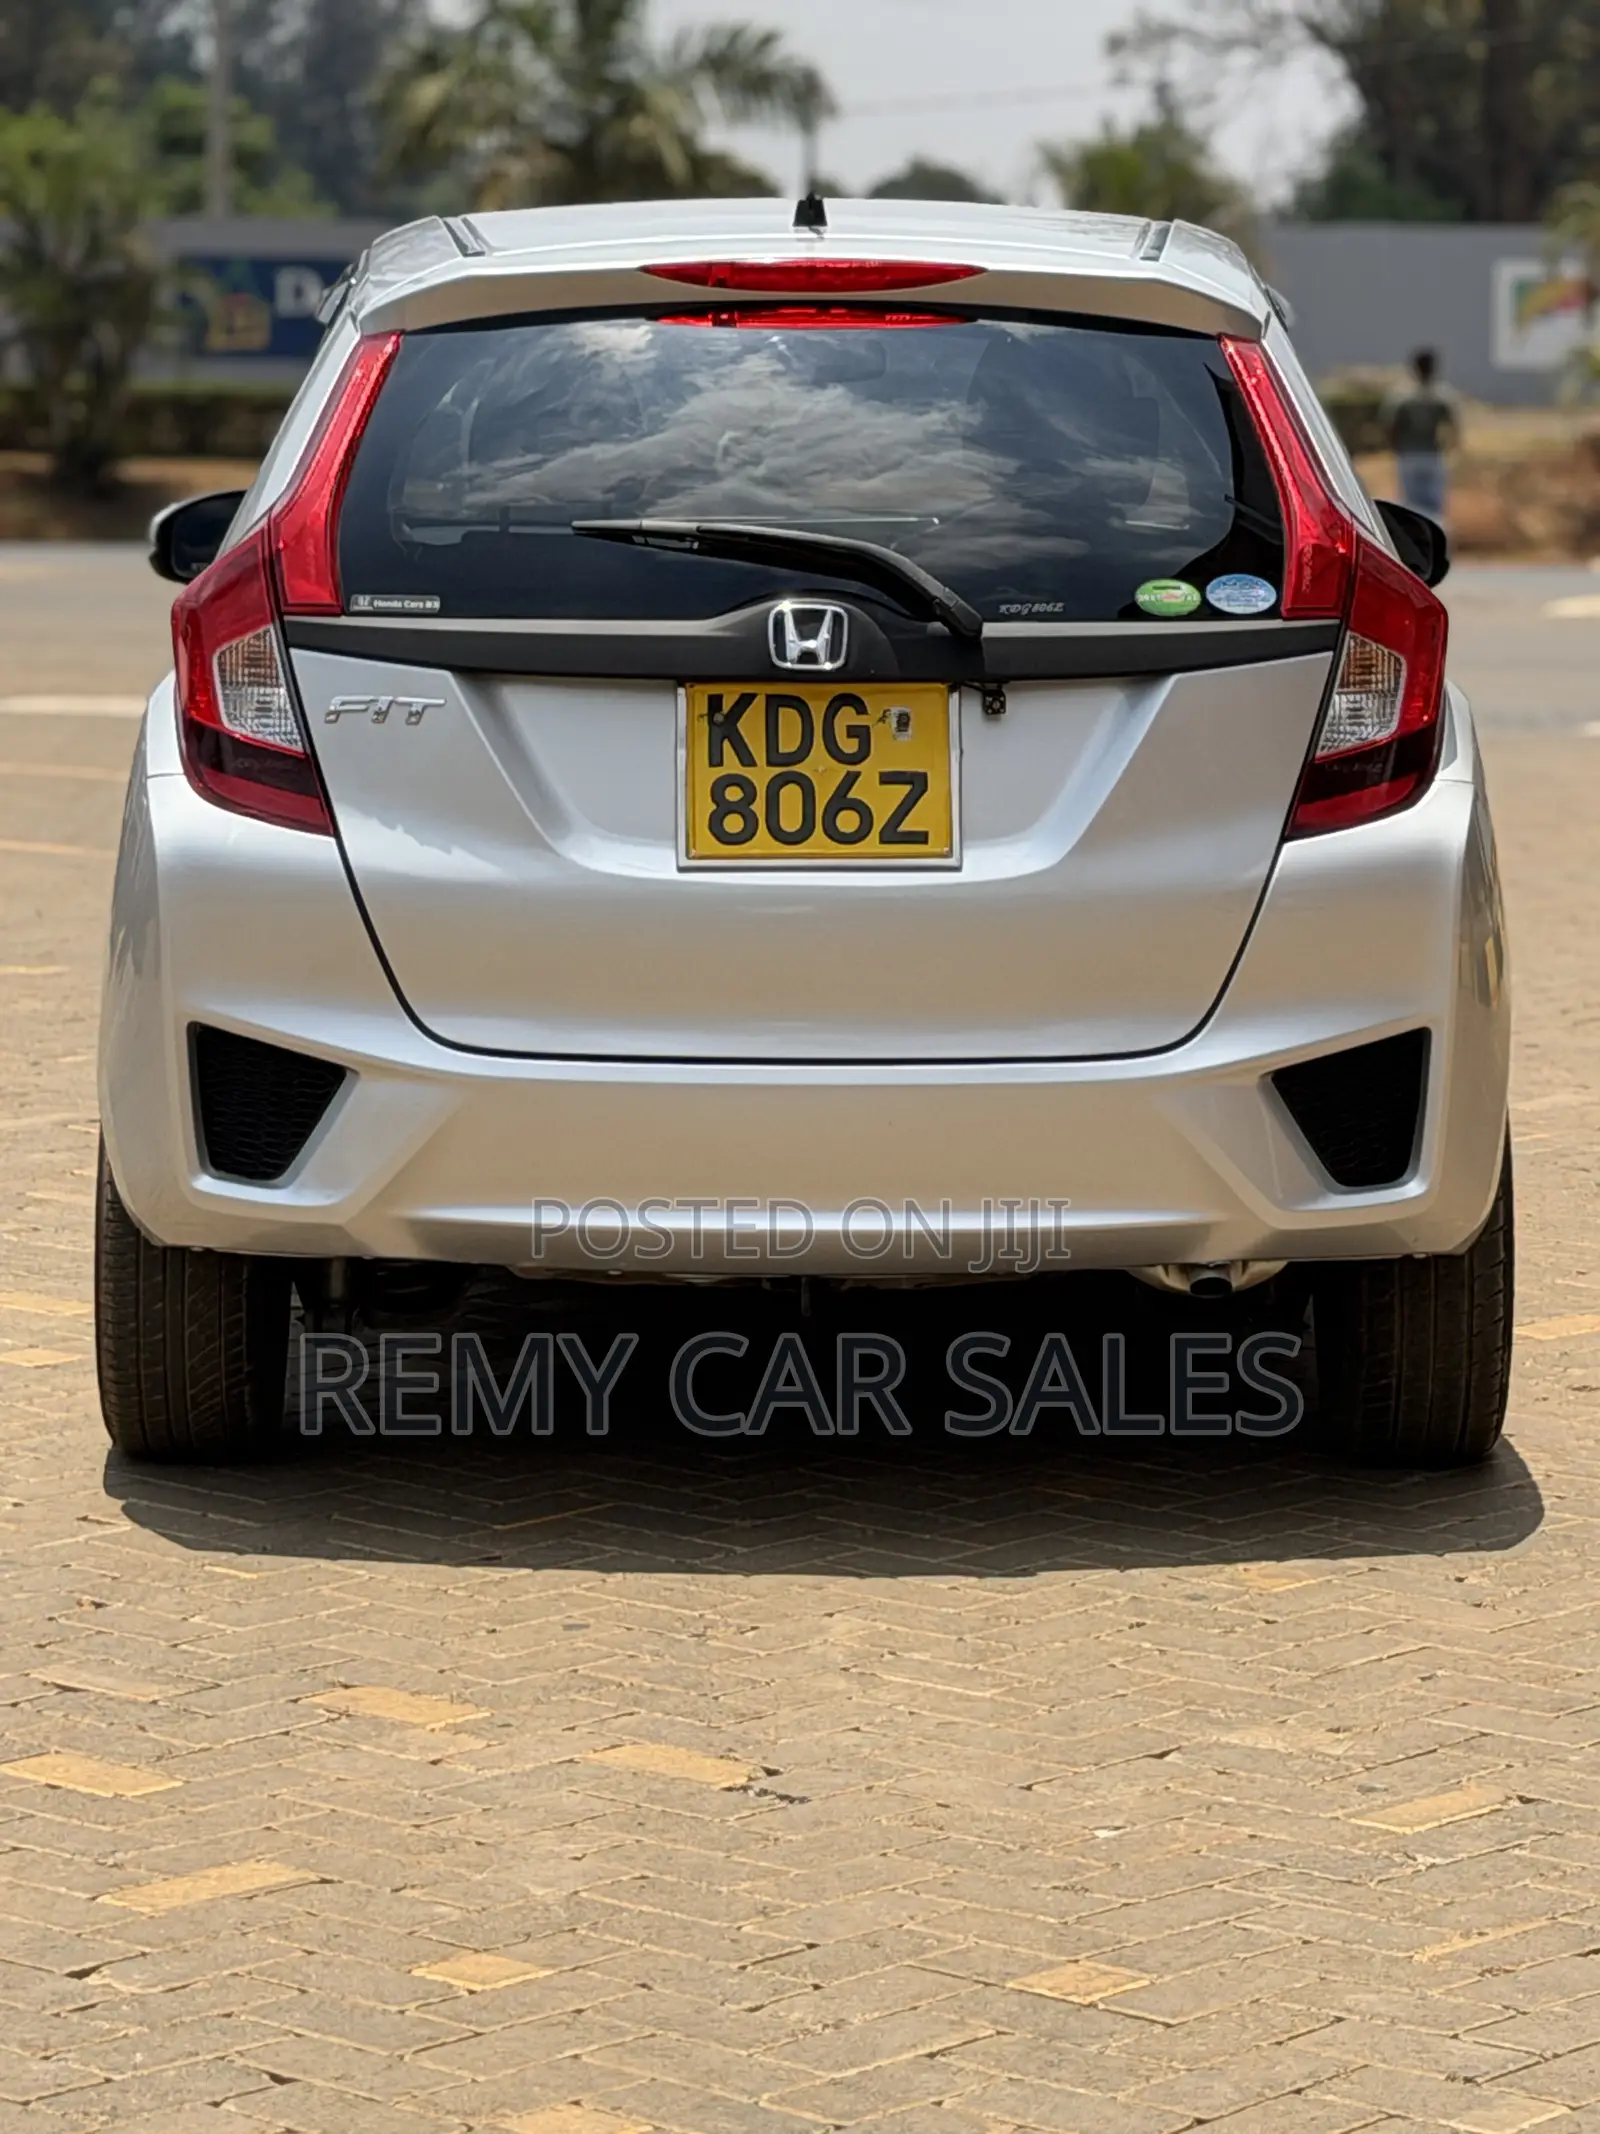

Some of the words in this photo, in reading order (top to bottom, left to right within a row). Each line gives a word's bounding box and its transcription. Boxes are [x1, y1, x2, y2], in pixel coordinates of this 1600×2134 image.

[371, 599, 402, 608] Honda
[324, 696, 446, 725] FIT
[707, 692, 872, 768] KDG
[707, 770, 930, 846] 806Z
